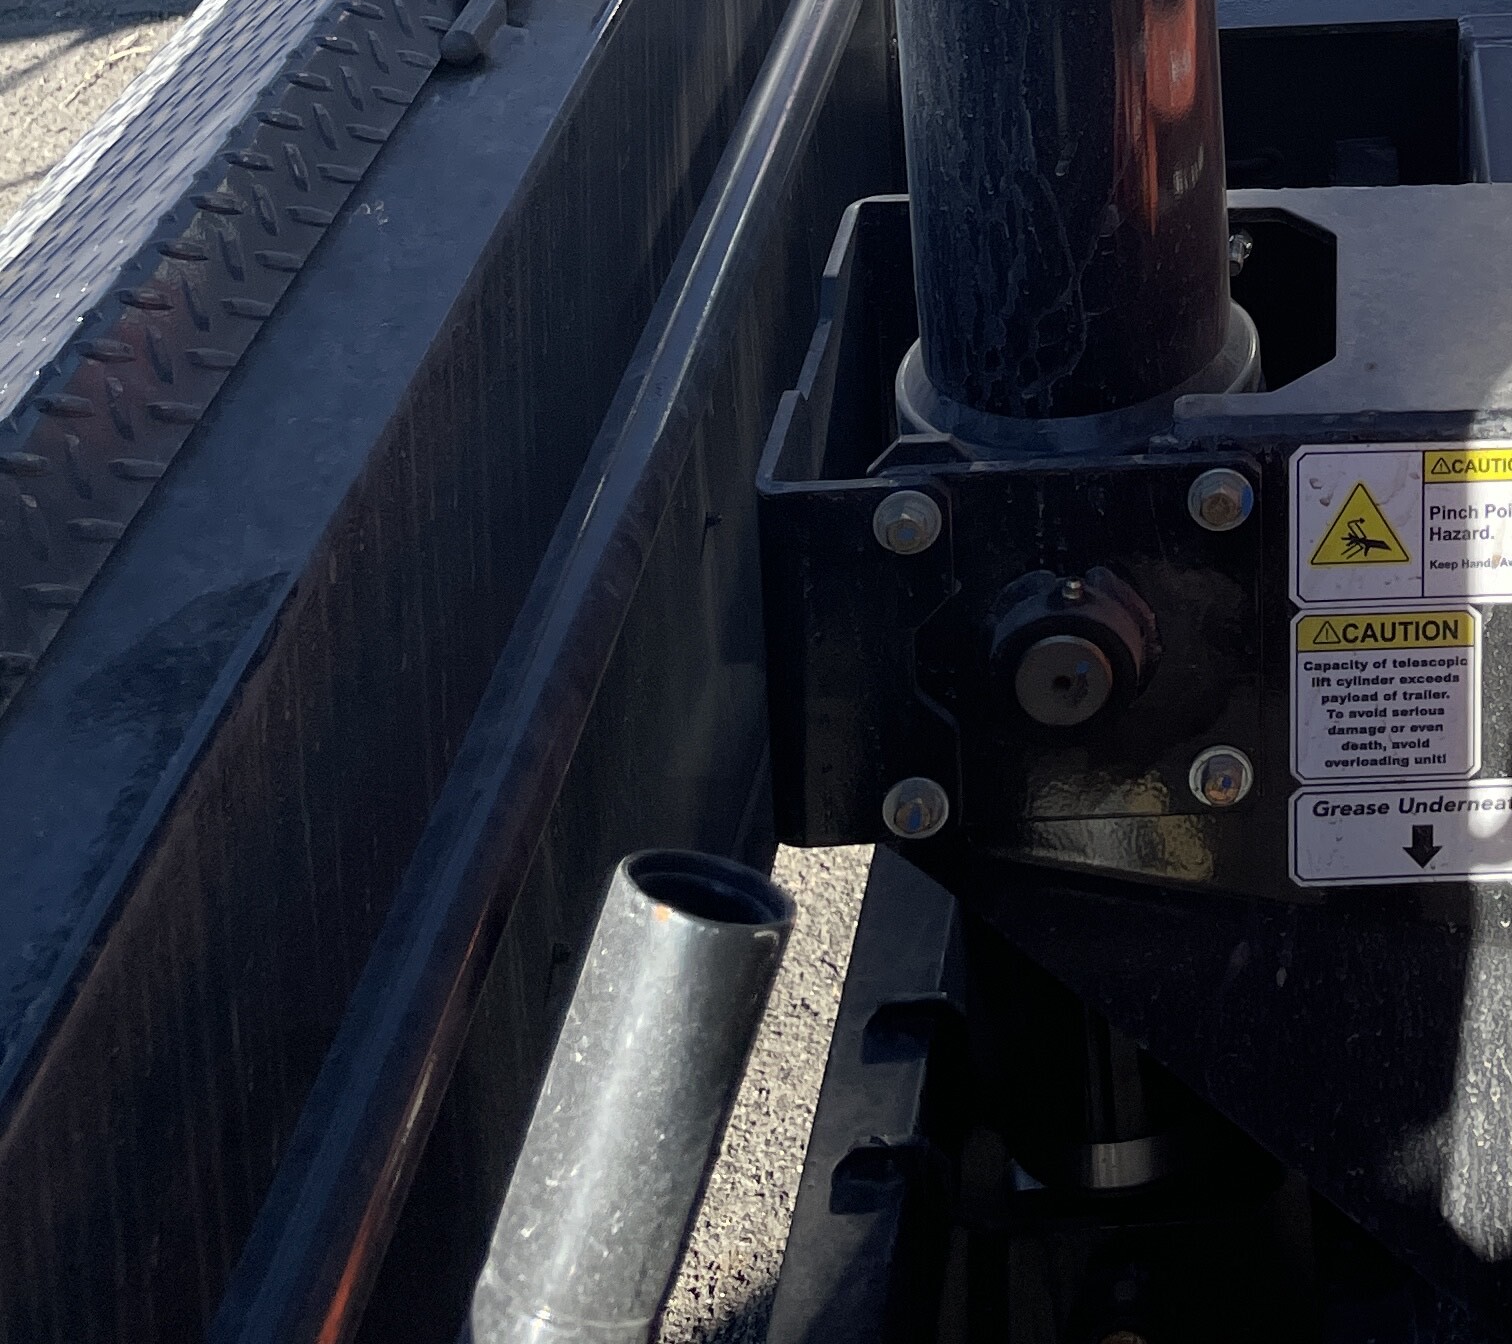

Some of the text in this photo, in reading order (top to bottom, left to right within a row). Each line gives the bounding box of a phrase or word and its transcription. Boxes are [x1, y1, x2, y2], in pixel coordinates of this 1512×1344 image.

[1429, 504, 1479, 521] Pinch
[1428, 525, 1496, 542] Hazard.
[1429, 559, 1459, 571] Keep
[1342, 619, 1459, 643] CAUTION
[1303, 656, 1468, 673] Capacity of telescopic
[1311, 673, 1460, 689] lift cylinder exceeds
[1321, 689, 1451, 706] payload of trailer.
[1326, 706, 1445, 720] To avoid serious
[1327, 723, 1444, 738] damage or even
[1341, 739, 1430, 752] death, avoid
[1324, 753, 1447, 769] overloading unit!
[1312, 799, 1390, 817] Grease
